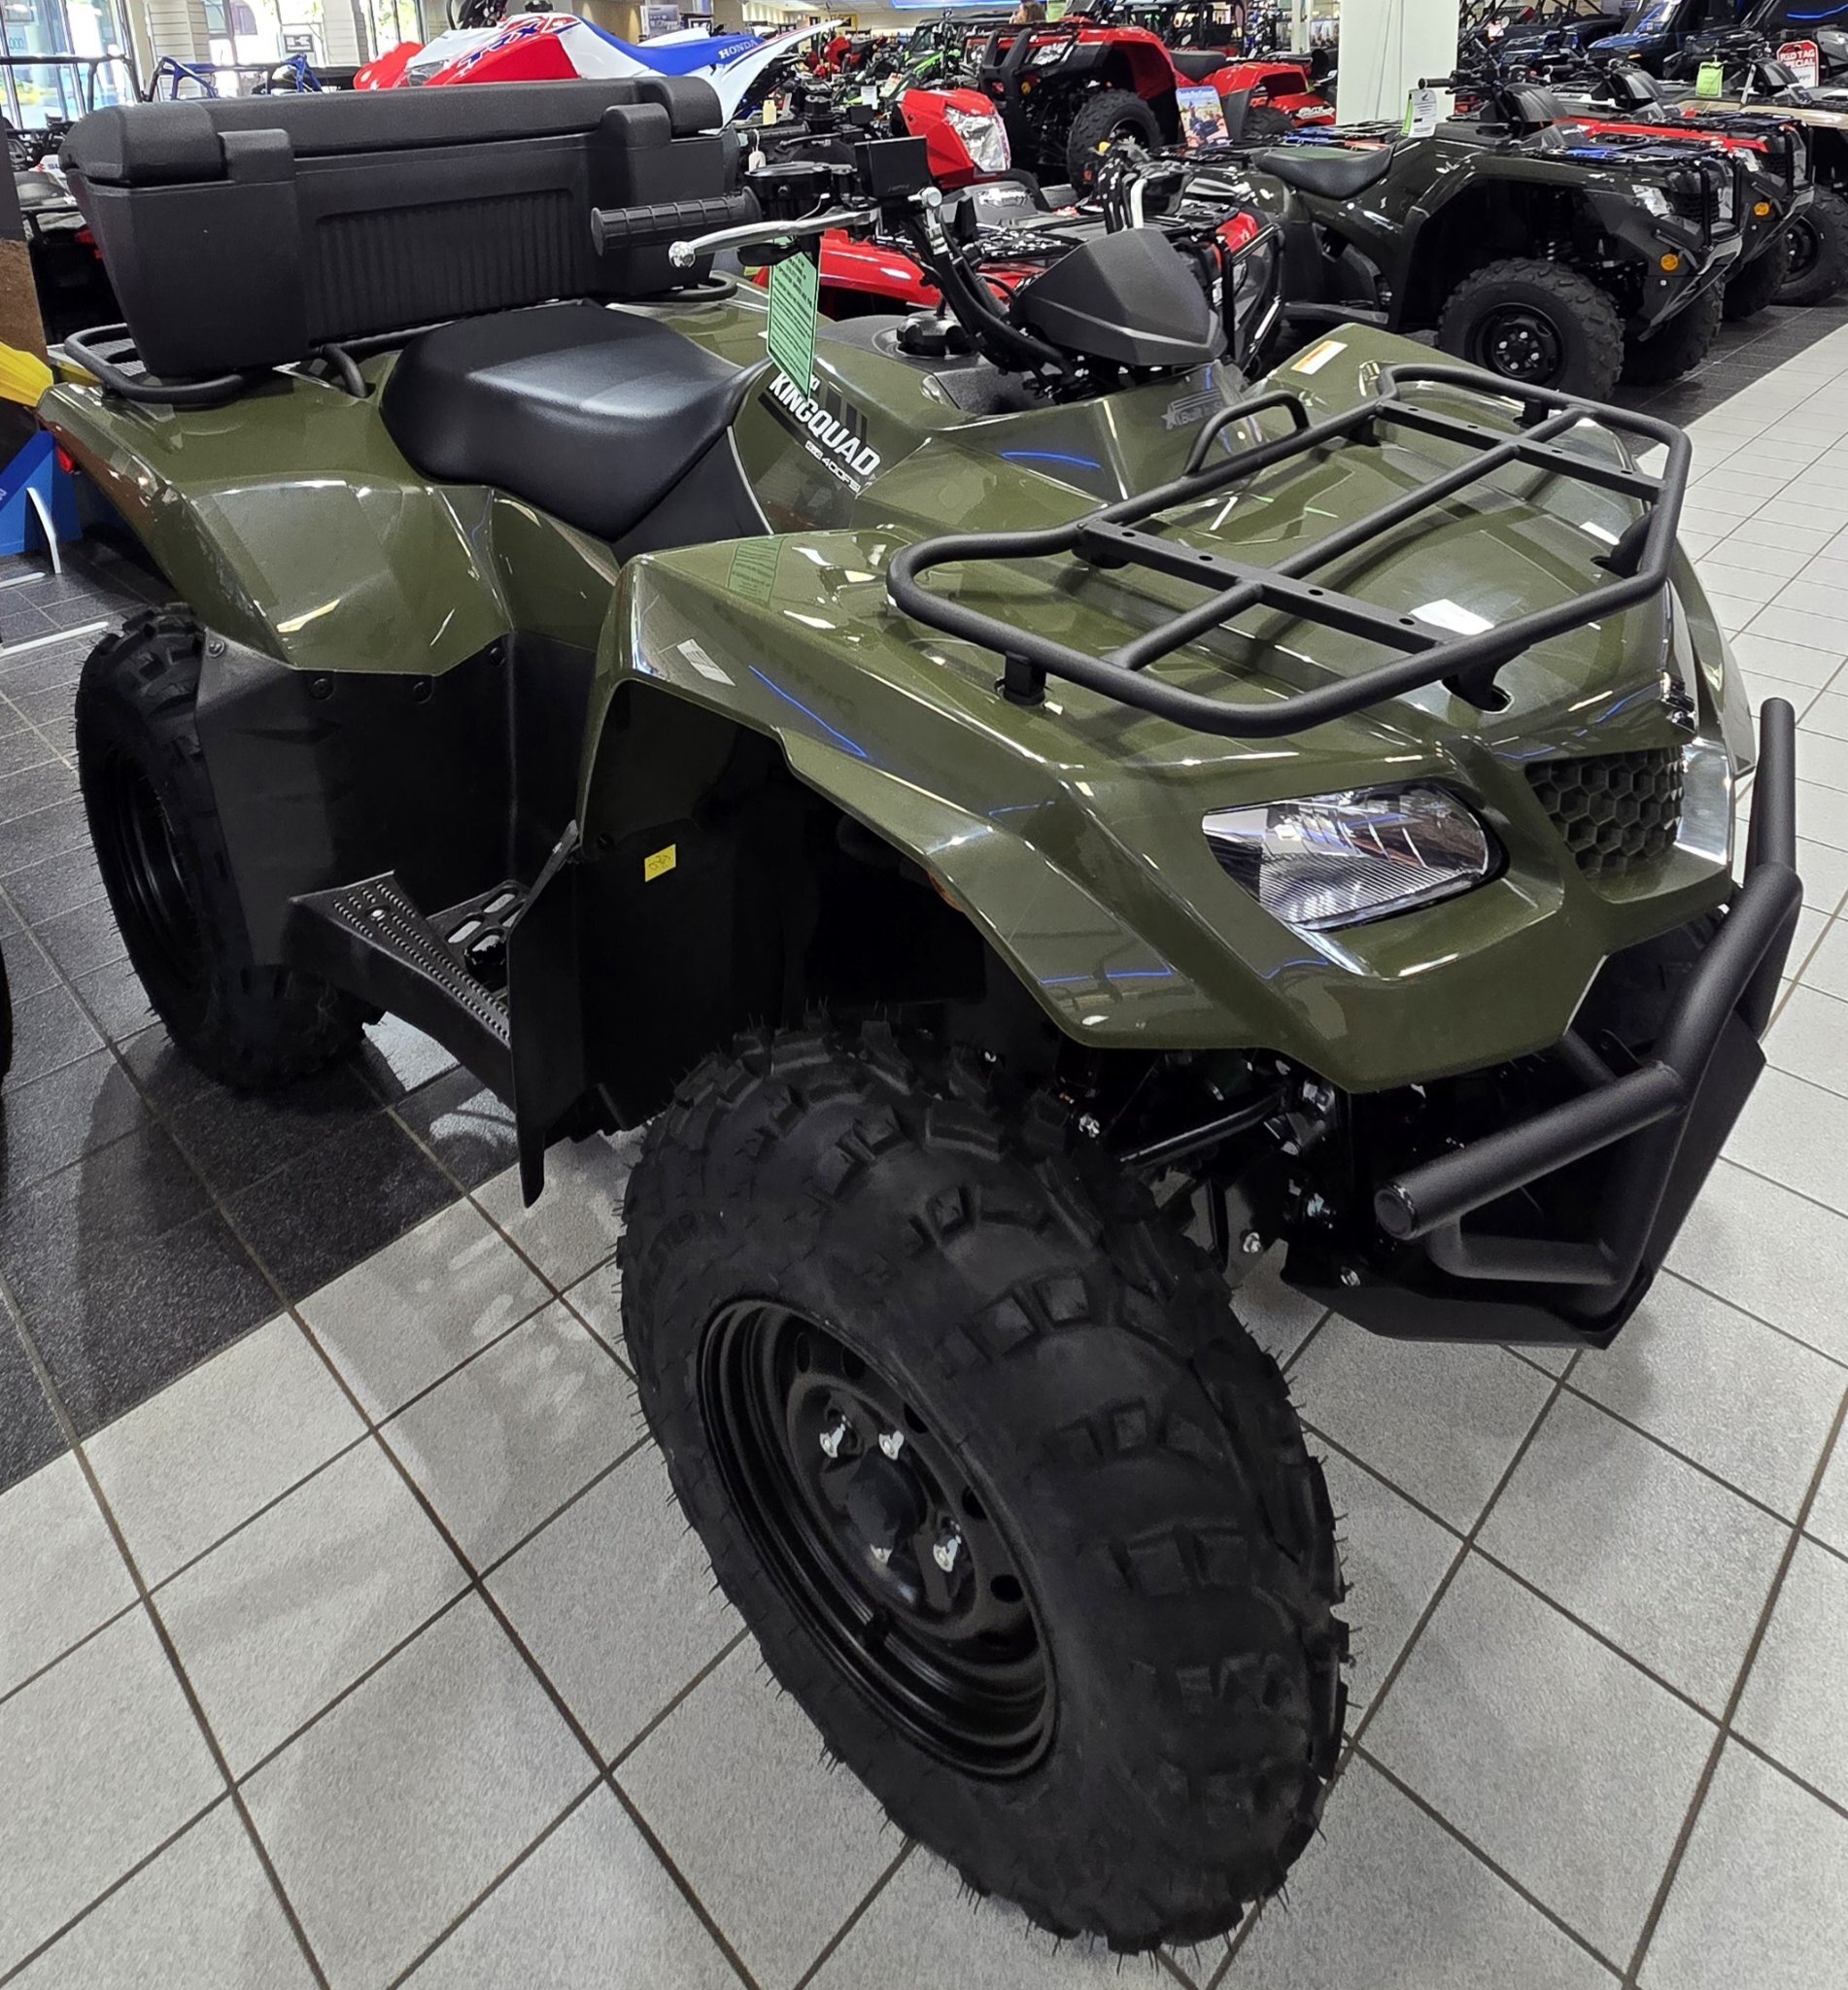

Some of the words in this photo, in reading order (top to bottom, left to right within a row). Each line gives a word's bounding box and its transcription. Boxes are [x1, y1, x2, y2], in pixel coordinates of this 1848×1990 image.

[718, 39, 759, 60] HONDA
[1780, 52, 1797, 61] RED
[1797, 50, 1815, 58] TAG
[769, 372, 881, 476] KINGQUAD
